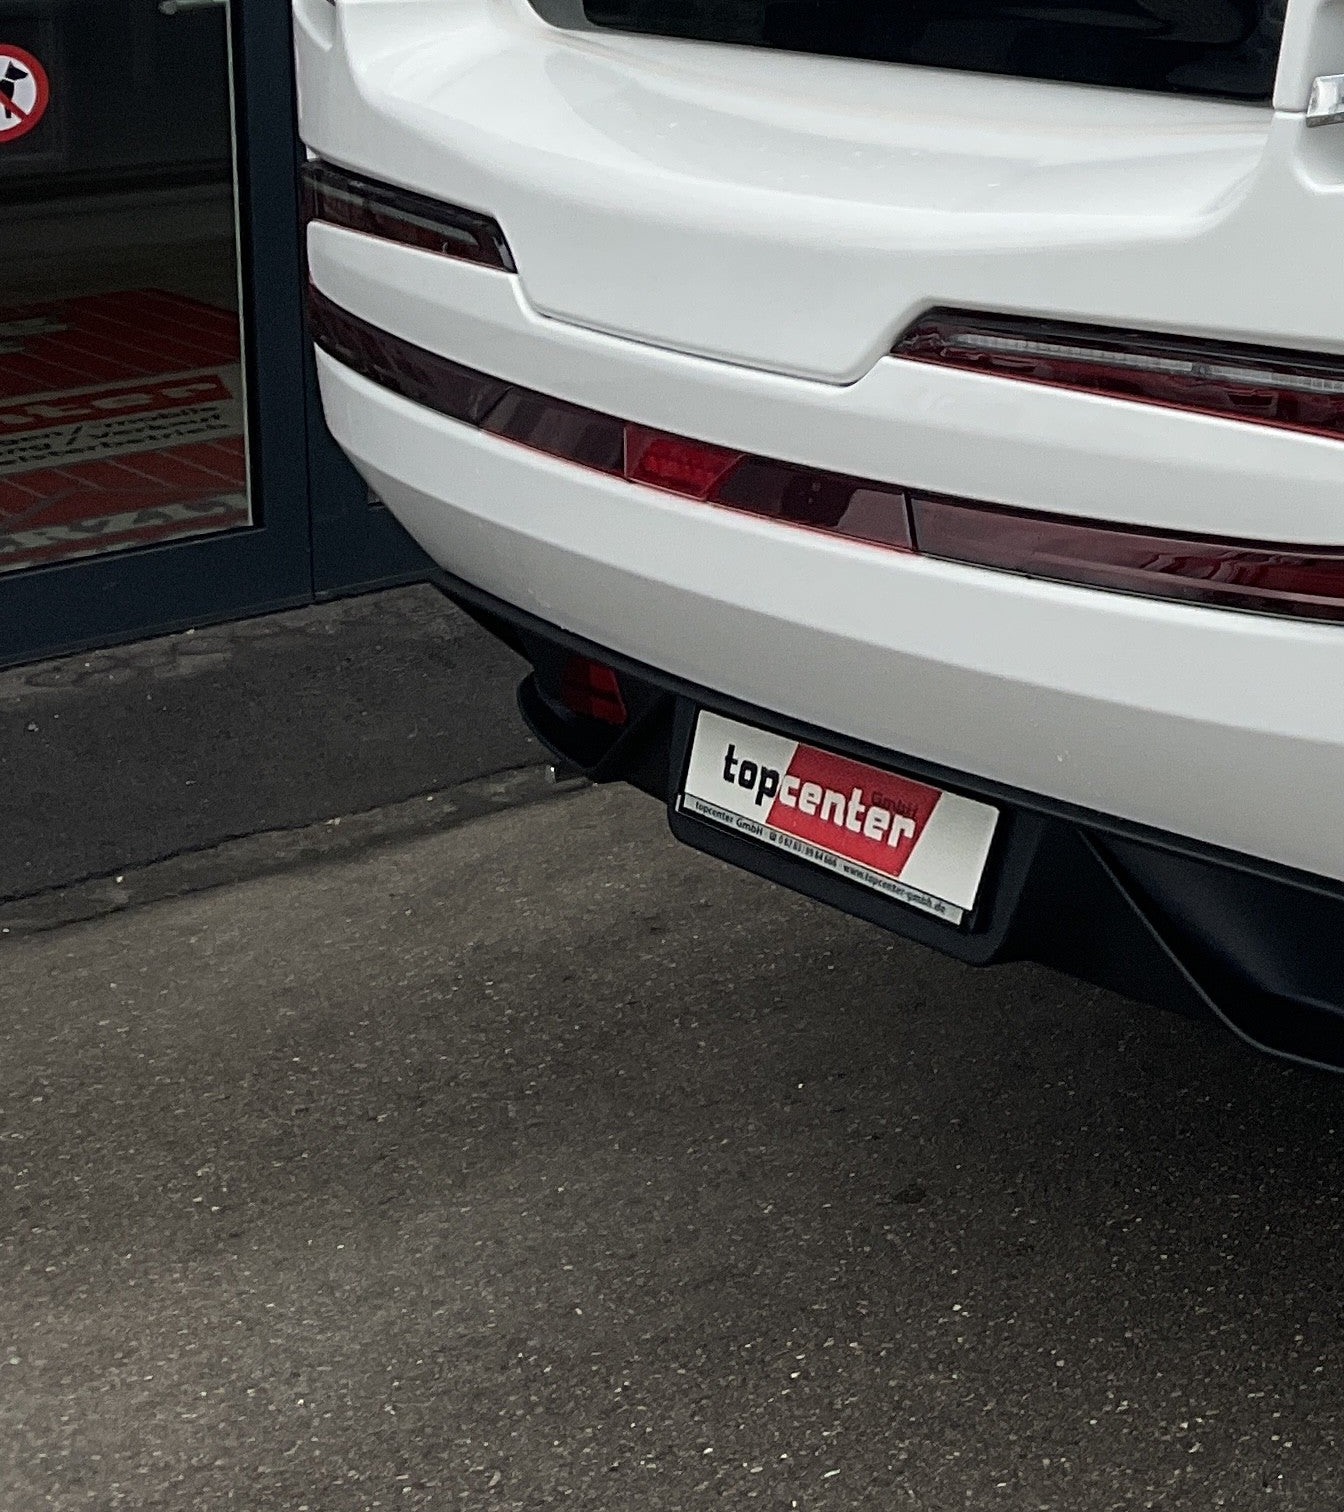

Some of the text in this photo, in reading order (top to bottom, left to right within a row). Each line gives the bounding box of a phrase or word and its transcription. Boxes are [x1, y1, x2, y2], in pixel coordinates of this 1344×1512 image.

[695, 800, 733, 824] topcenter
[735, 818, 763, 836] GmbH
[722, 743, 917, 848] topcenter
